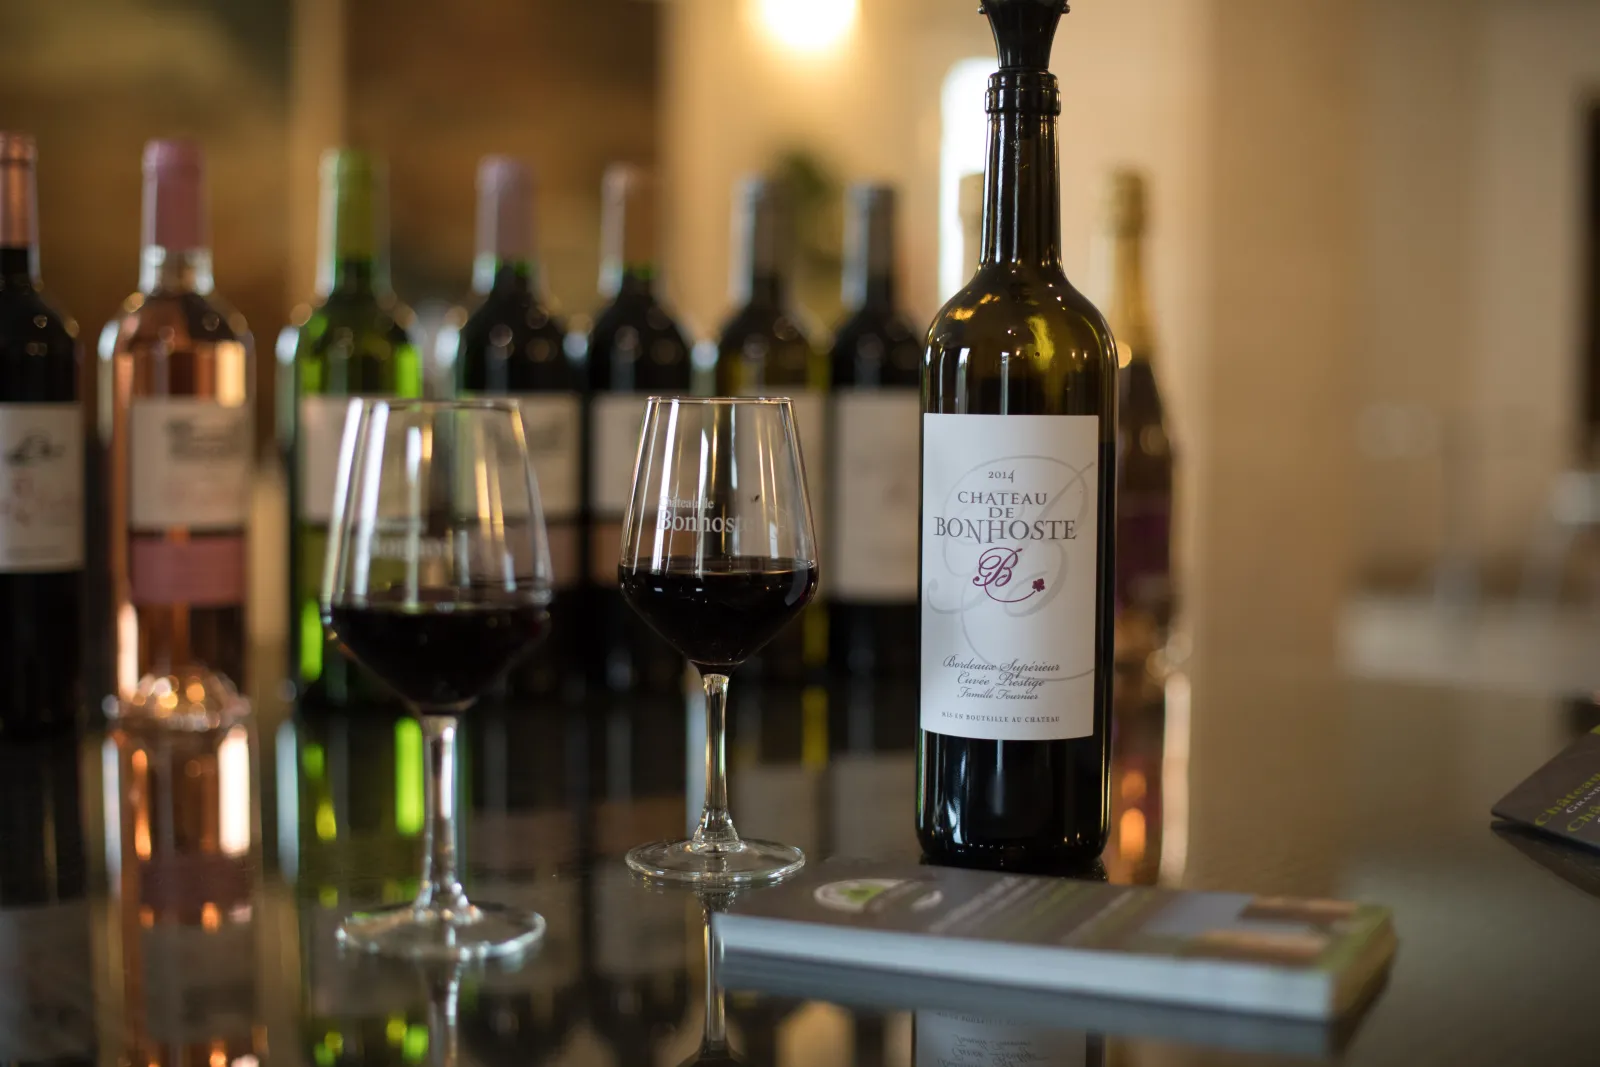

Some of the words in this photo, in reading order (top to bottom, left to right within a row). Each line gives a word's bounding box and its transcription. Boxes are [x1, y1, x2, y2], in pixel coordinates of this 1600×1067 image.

[988, 469, 1015, 483] 2014
[957, 491, 1047, 506] CHATEAU
[988, 507, 1015, 519] DE
[933, 516, 1078, 544] BONHOSTE
[942, 654, 997, 671] Bordeaux
[999, 658, 1060, 679] Supérieur
[957, 671, 990, 686] Cuvée
[995, 672, 1045, 694] Prestige
[957, 686, 995, 699] Famille
[996, 689, 1039, 700] Fournier
[966, 714, 1009, 722] BOUTEILLE
